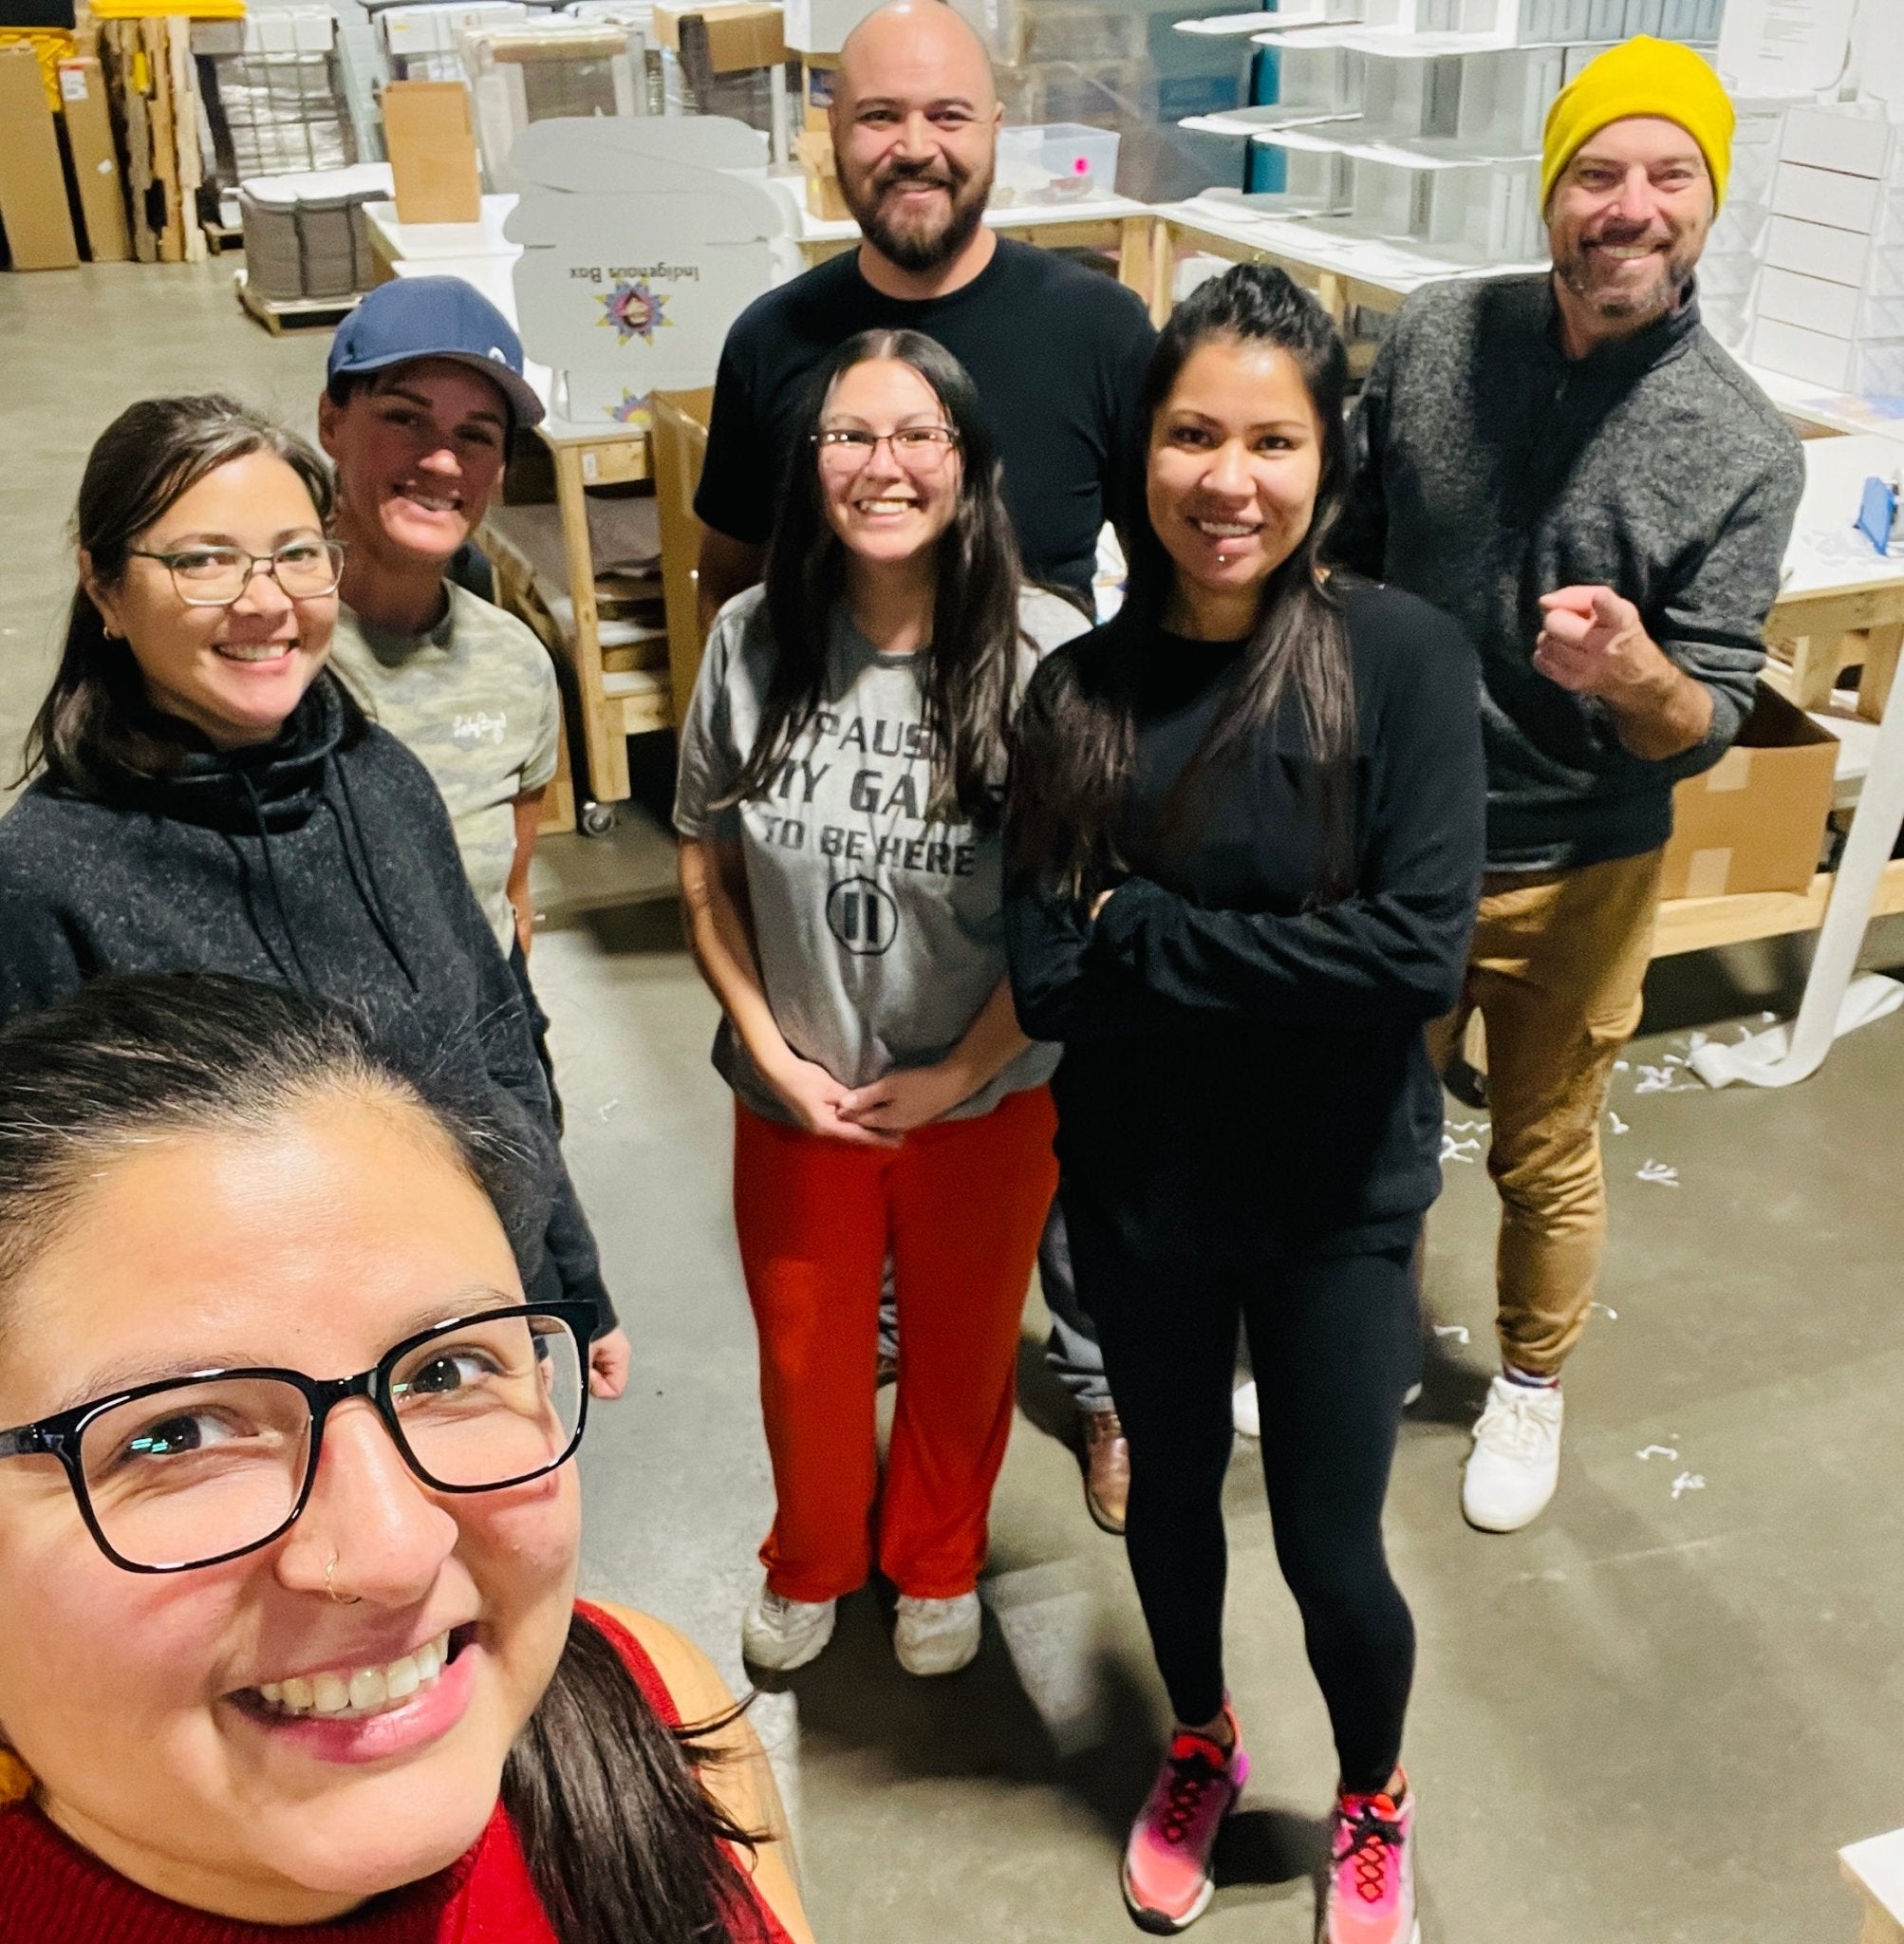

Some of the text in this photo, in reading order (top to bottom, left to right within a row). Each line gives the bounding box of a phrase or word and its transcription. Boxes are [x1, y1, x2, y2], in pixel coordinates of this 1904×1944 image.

[569, 261, 700, 284] Indigenous Box
[814, 710, 931, 759] PAUS
[849, 768, 923, 819] GA
[763, 813, 976, 876] TO BE HERE
